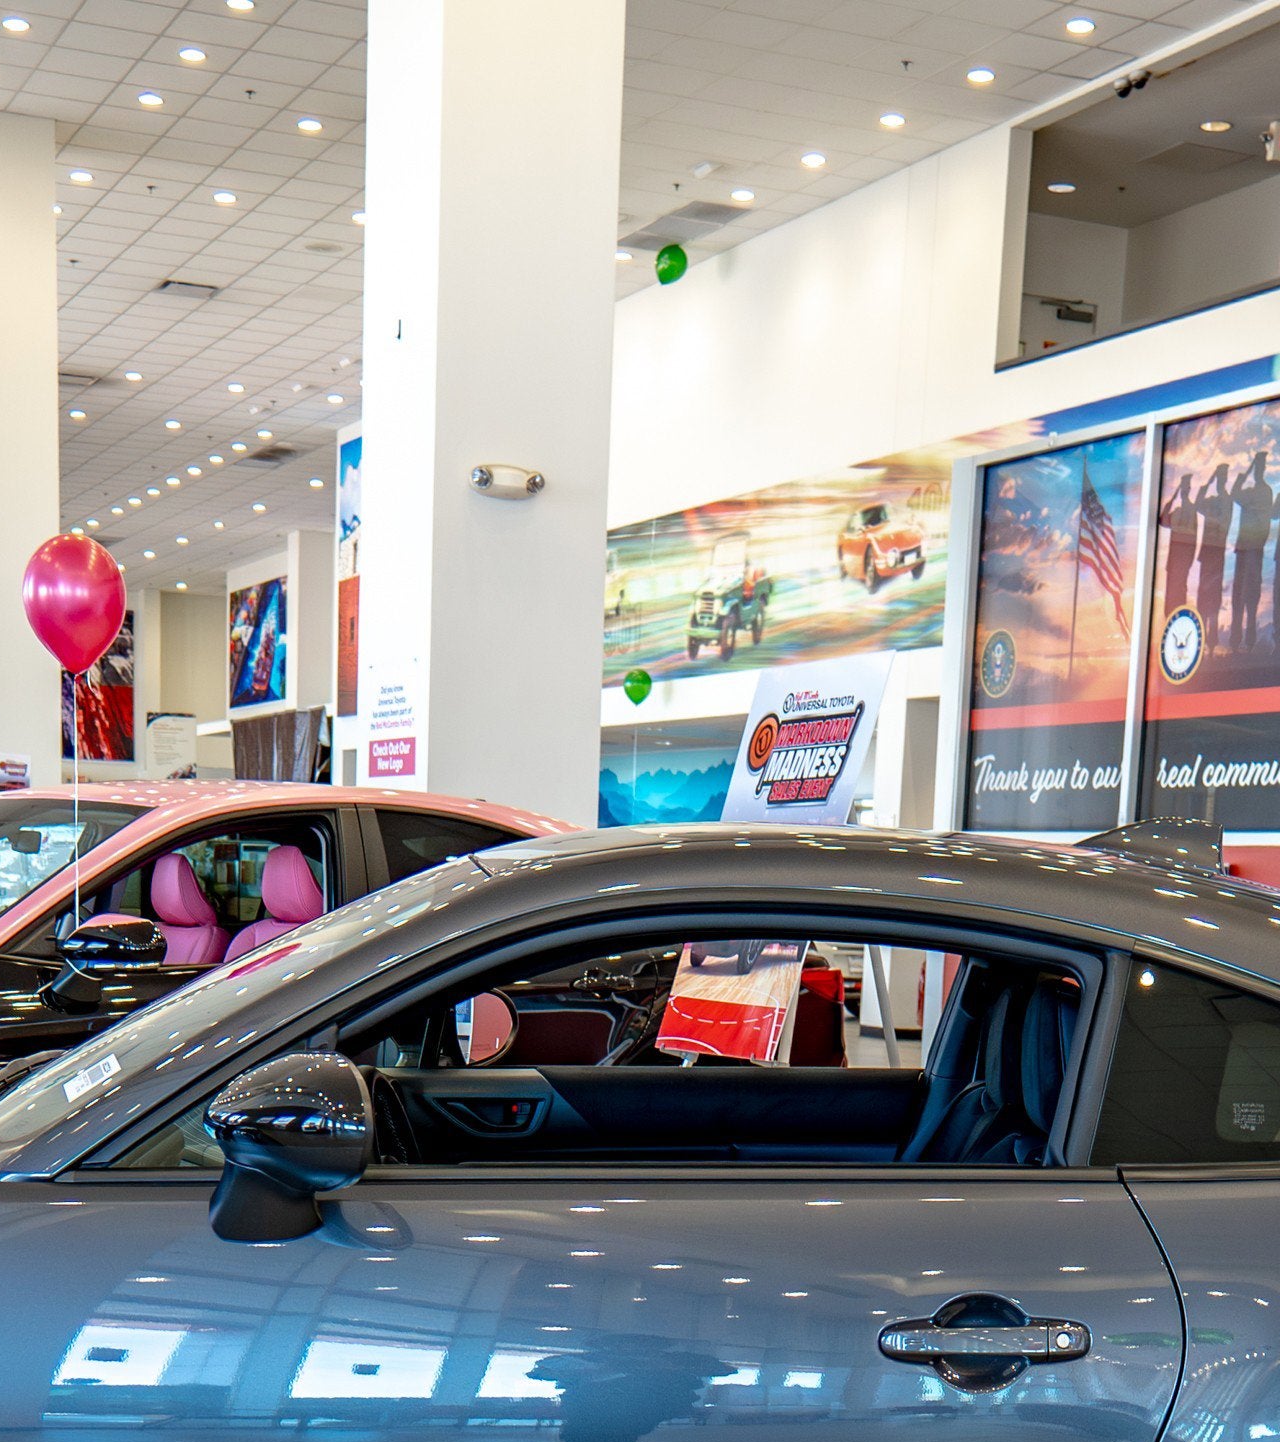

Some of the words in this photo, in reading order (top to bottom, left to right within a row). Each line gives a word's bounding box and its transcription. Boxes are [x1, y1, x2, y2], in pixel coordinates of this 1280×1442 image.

[792, 698, 827, 713] UNIVERSAL
[829, 695, 855, 709] TOYOTA
[776, 717, 855, 748] MARKDOWN
[372, 741, 388, 757] Check
[389, 742, 399, 756] Out
[399, 740, 410, 755] Our
[377, 758, 389, 770] New
[390, 758, 404, 773] Logo
[763, 745, 848, 782] MADNESS
[1156, 753, 1201, 789] real
[769, 780, 801, 800] SALES
[799, 777, 834, 800] EVENT
[974, 755, 1028, 794] Thank
[1031, 765, 1067, 803] you
[1070, 759, 1089, 790] to
